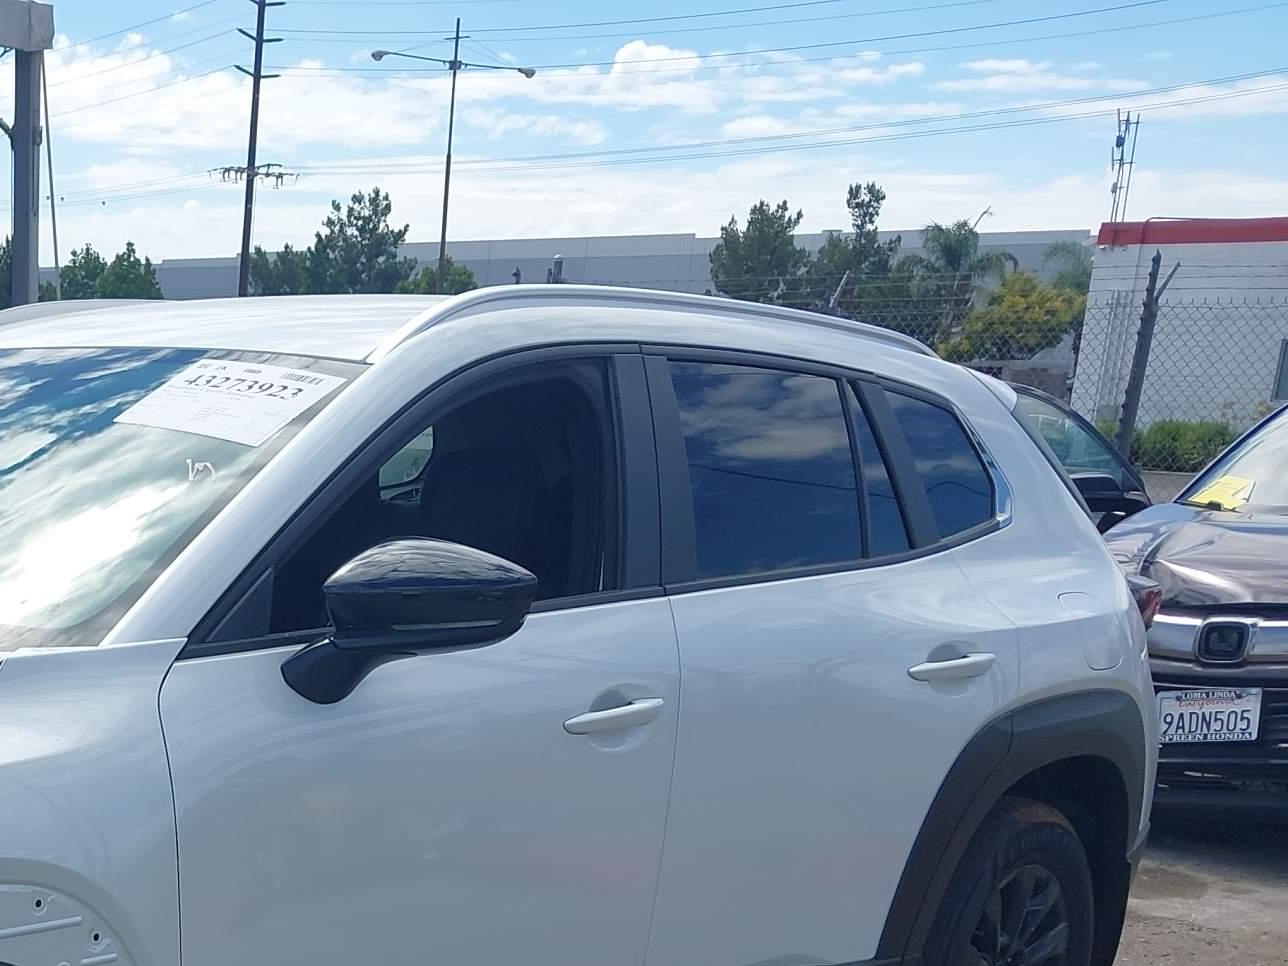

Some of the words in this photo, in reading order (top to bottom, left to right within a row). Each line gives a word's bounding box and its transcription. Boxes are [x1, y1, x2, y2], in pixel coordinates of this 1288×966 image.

[184, 374, 304, 401] 43273923
[1182, 692, 1207, 700] LOMA
[1209, 690, 1237, 699] LINDA
[1162, 709, 1252, 735] 9ADN505
[1206, 732, 1252, 741] HONDA
